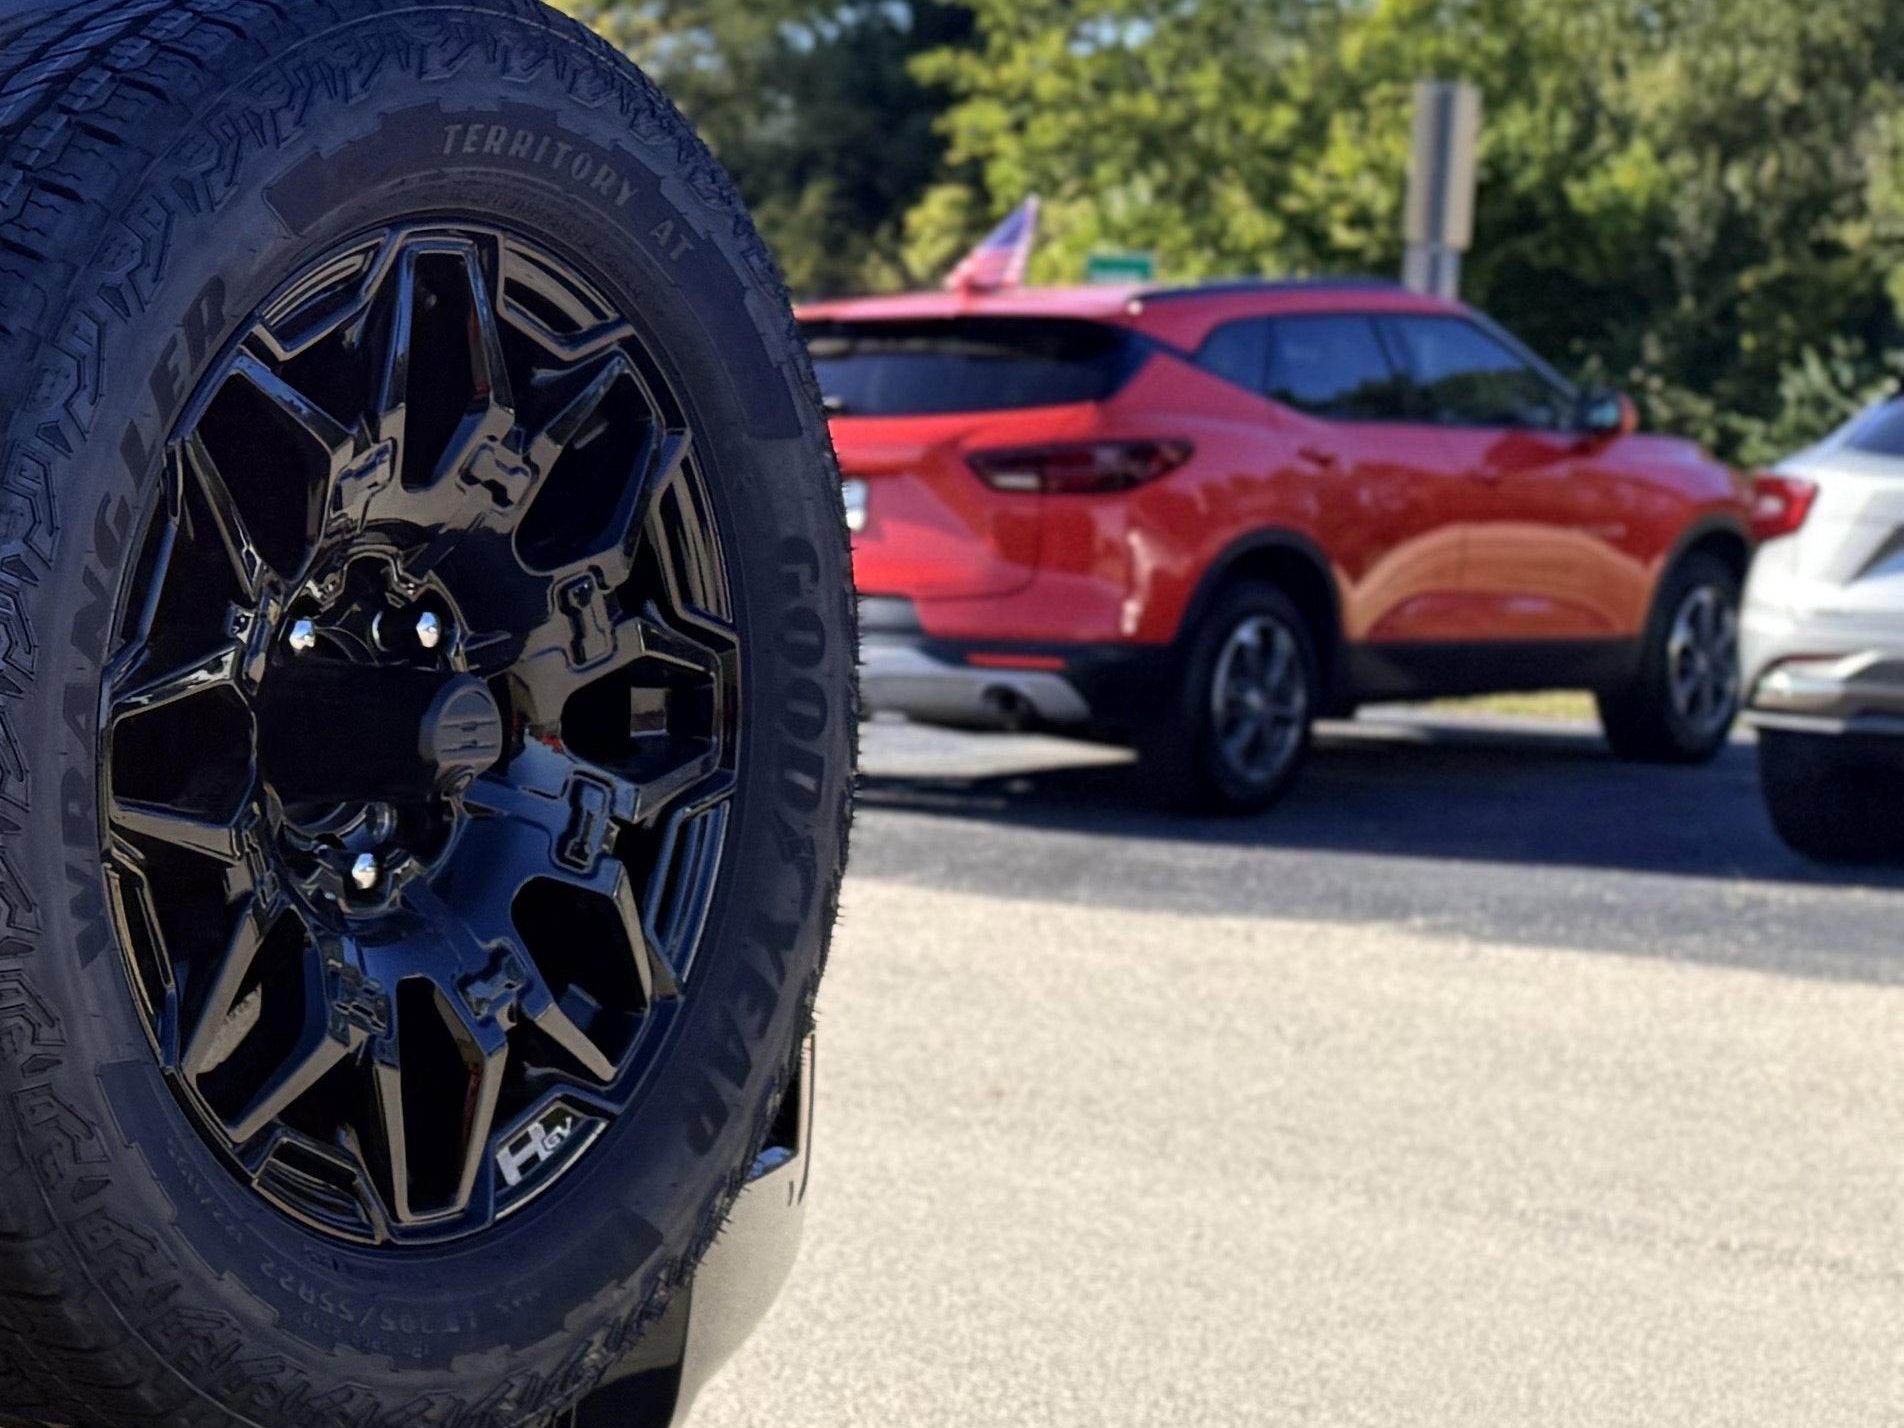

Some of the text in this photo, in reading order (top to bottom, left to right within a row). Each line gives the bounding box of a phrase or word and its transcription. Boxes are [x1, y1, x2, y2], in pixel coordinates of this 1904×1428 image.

[442, 122, 638, 207] TERRITORY
[650, 219, 695, 261] AT
[61, 276, 226, 970] WRANGLER
